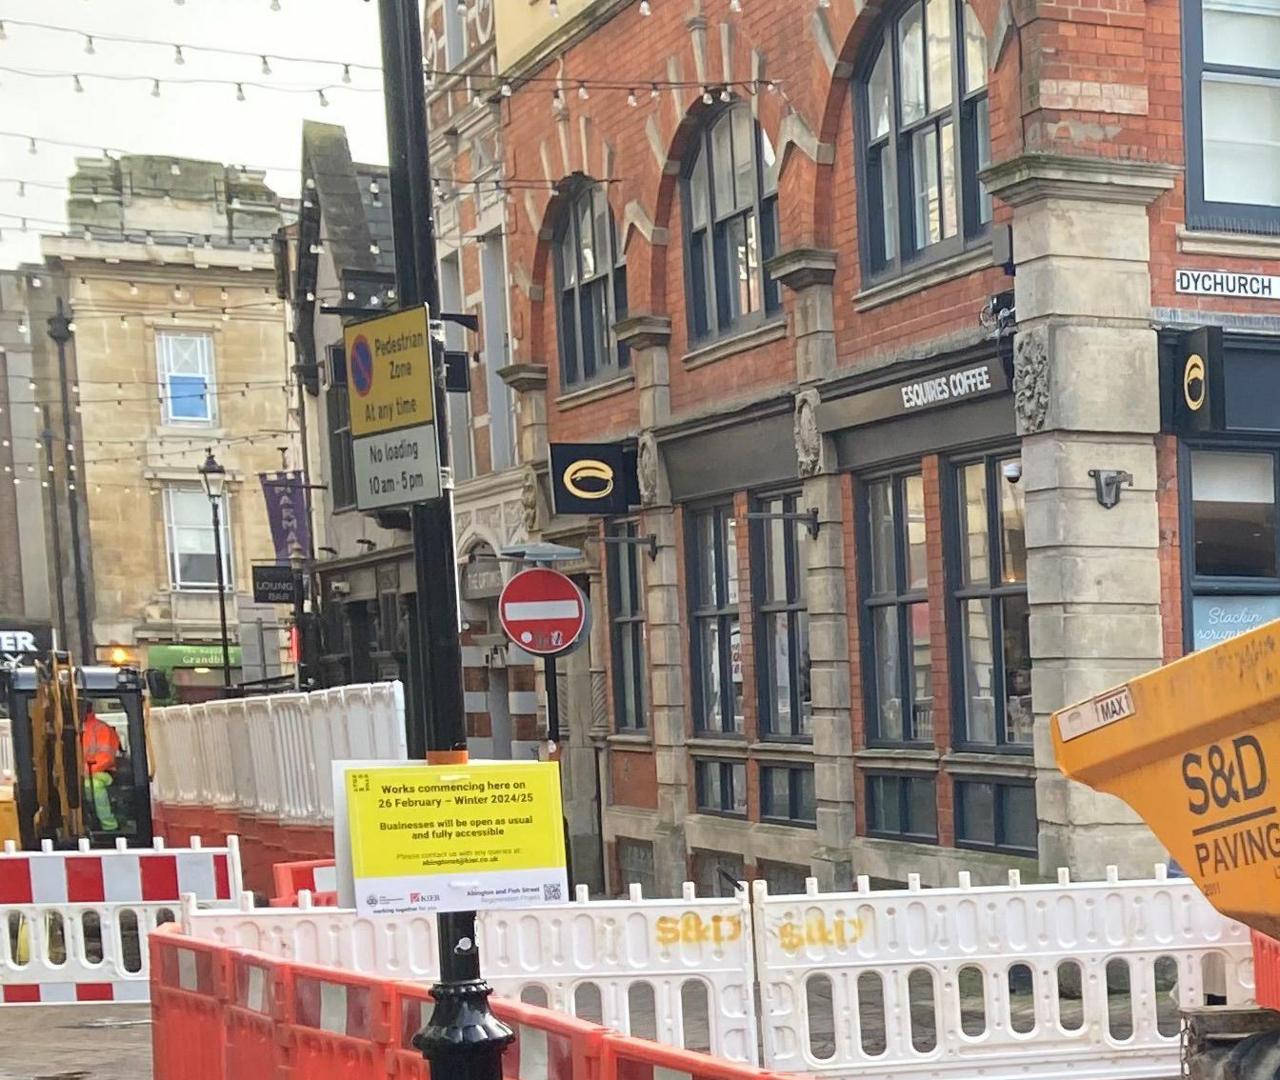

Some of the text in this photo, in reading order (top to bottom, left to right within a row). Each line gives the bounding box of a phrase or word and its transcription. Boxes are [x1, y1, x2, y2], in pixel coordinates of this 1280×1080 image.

[1179, 272, 1273, 296] DYCHURCH
[374, 332, 424, 358] Pedestrian
[390, 361, 412, 380] Zone
[901, 366, 991, 408] ESQUIRES COFFEE
[365, 396, 417, 422] At any time
[369, 440, 419, 463] No loading
[0, 630, 38, 651] ER
[1100, 696, 1126, 722] MAX
[1182, 734, 1268, 816] S&D
[381, 780, 526, 795] Works commencing here on
[378, 798, 393, 809] 26
[394, 796, 442, 810] February
[454, 794, 488, 805] Winter
[490, 792, 534, 804] 2024/25
[380, 815, 533, 832] Businesses will be open as usual
[412, 828, 505, 841] and fully accessible
[655, 914, 742, 946] S&D
